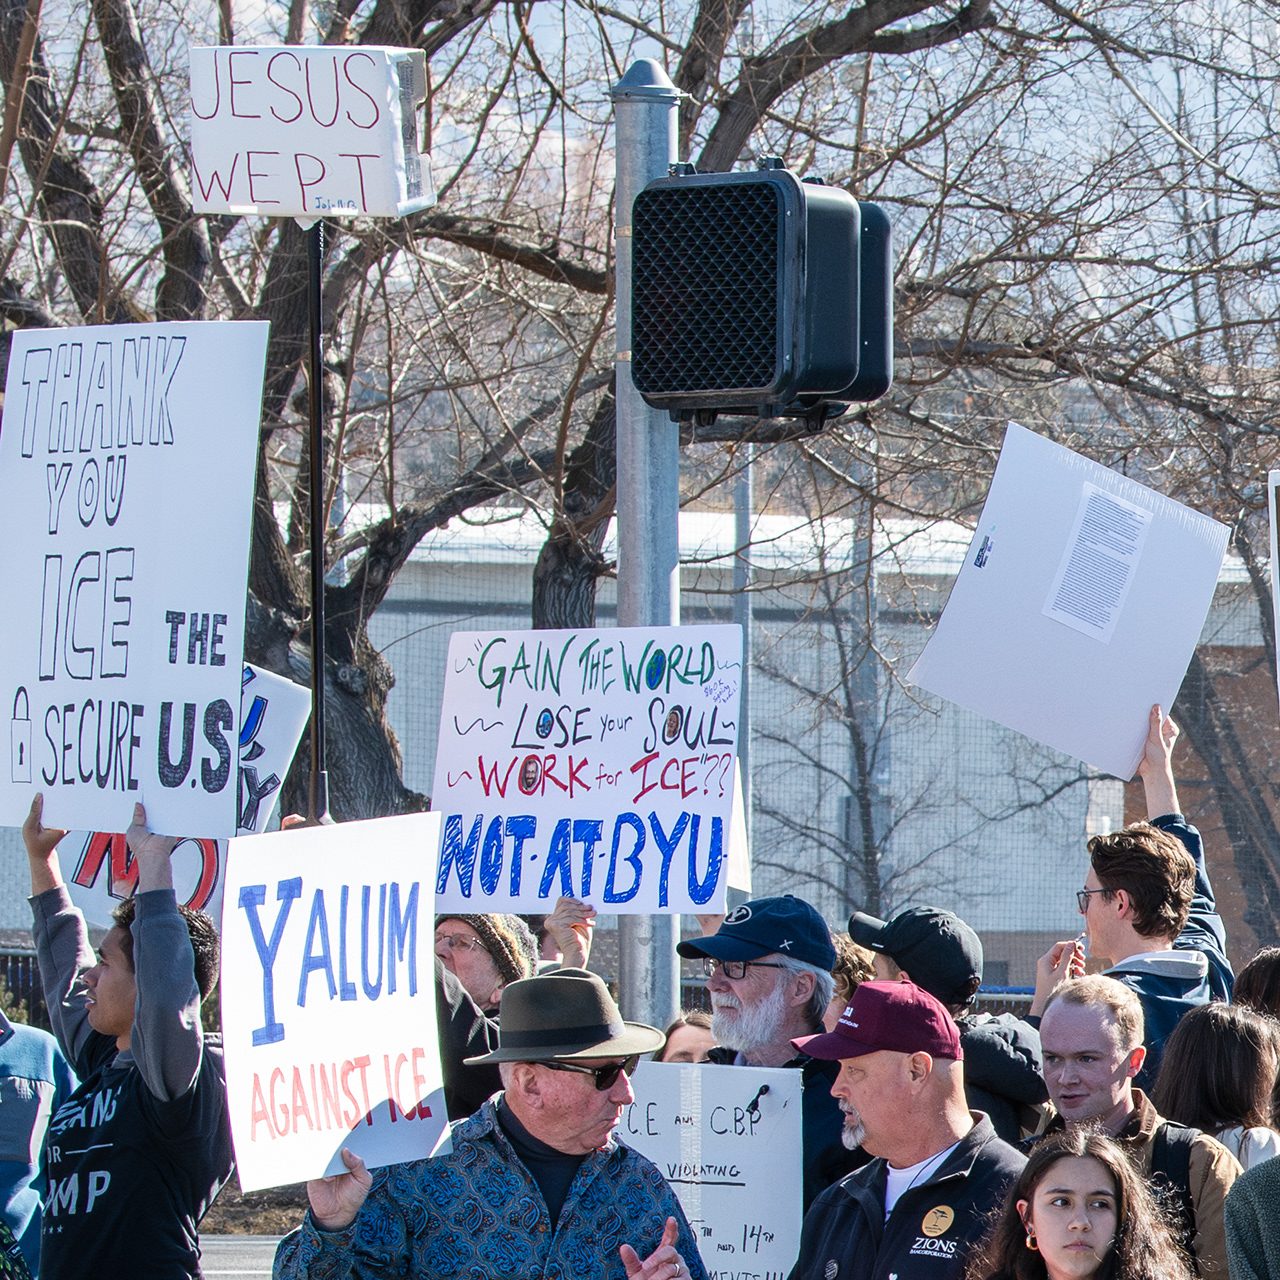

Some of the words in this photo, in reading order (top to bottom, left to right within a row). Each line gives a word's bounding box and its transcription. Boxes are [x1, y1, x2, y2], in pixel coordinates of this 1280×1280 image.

[191, 50, 380, 129] JESUS
[191, 150, 380, 212] WEPT
[22, 336, 187, 458] THANK
[47, 454, 127, 535] YOU
[39, 547, 136, 682] ICE
[165, 610, 228, 667] THE
[578, 638, 617, 696] THE
[619, 639, 715, 695] WORLD
[42, 698, 145, 793] SECURE
[511, 702, 593, 749] LOSE
[599, 715, 633, 742] your
[643, 696, 735, 754] SOUL
[477, 754, 592, 799] WORK
[595, 756, 623, 787] for
[238, 876, 420, 1047] YALUM
[251, 1053, 373, 1143] AGAINST
[383, 1047, 433, 1123] ICE
[666, 1162, 741, 1178] VIOLATING
[911, 1236, 958, 1254] ZIONS
